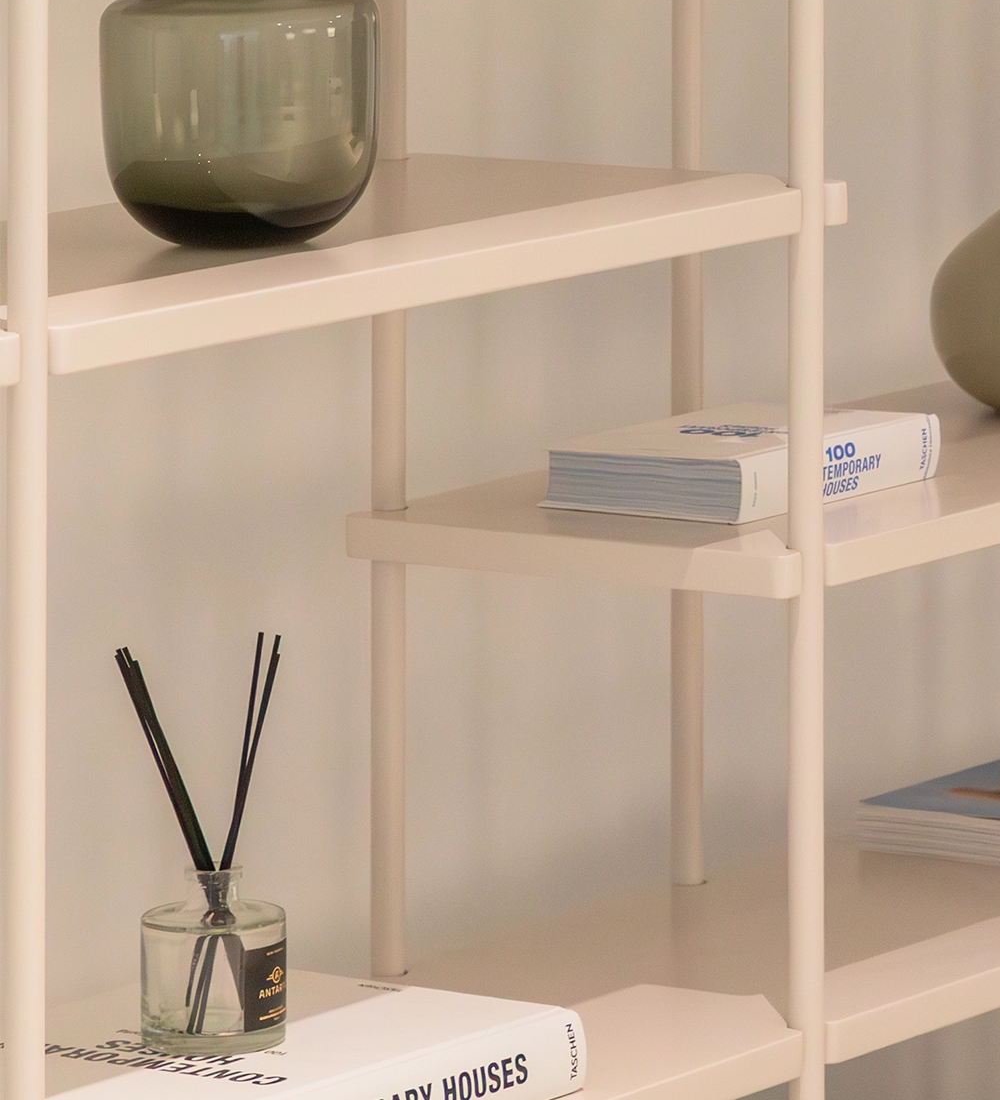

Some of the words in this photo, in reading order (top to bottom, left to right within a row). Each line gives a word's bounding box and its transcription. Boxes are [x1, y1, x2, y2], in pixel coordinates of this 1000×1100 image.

[825, 441, 856, 462] 100
[919, 428, 927, 470] TASCHEN
[45, 1044, 287, 1085] CONTEMPORA
[565, 1023, 578, 1081] TASCHEN
[442, 1053, 529, 1100] HOUSES
